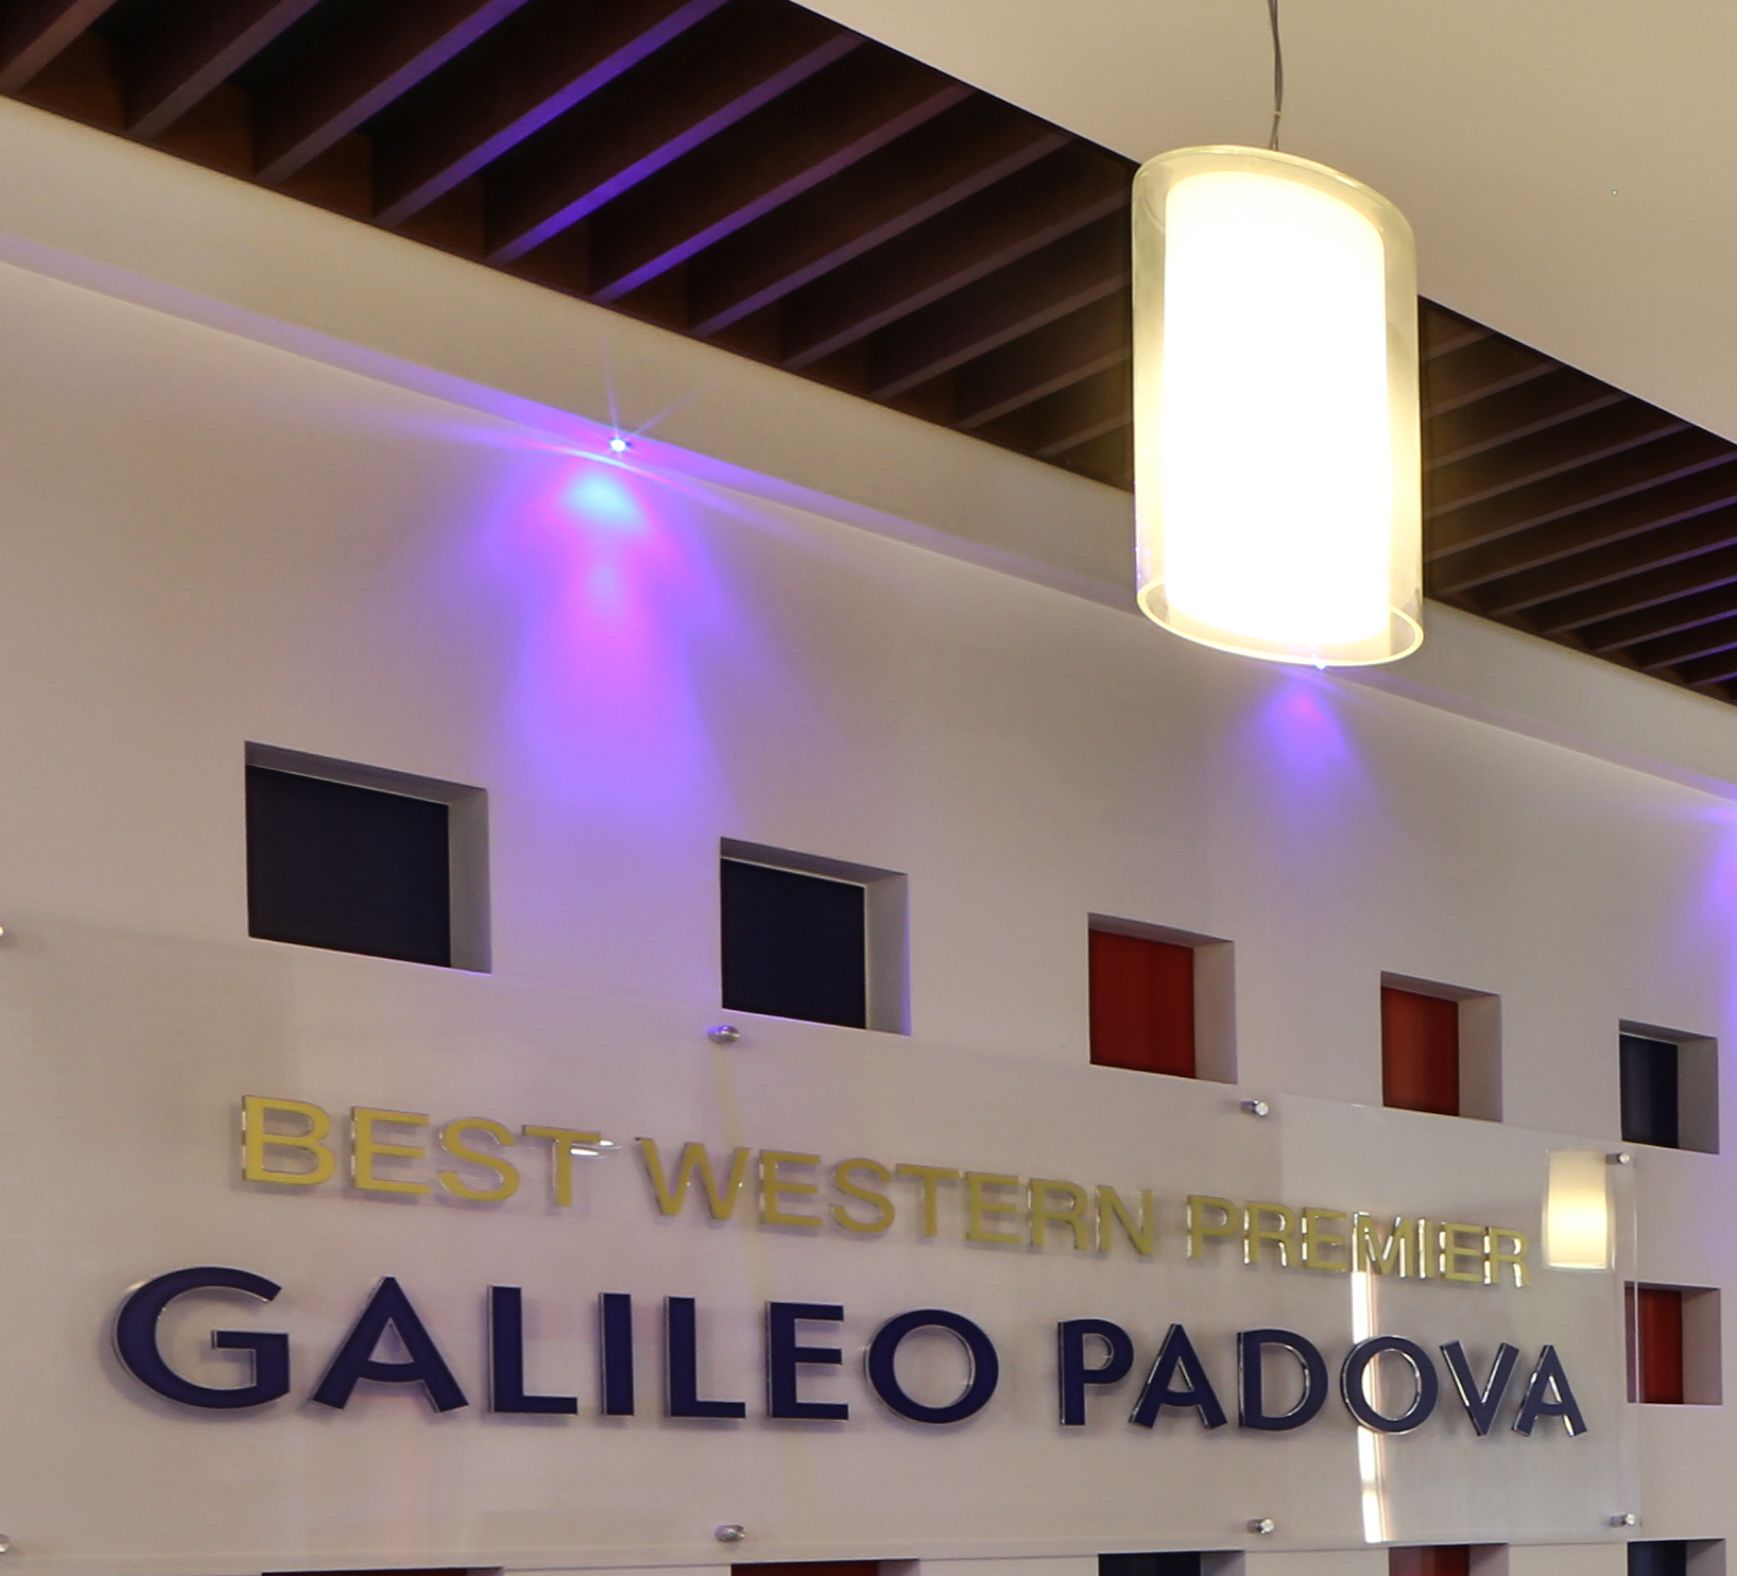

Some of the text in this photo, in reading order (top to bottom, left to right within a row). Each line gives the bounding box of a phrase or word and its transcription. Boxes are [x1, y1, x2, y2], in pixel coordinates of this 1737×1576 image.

[241, 1094, 1531, 1287] BEST WESTERN PREMIER
[113, 1266, 1589, 1437] GALILEO PADOVA
